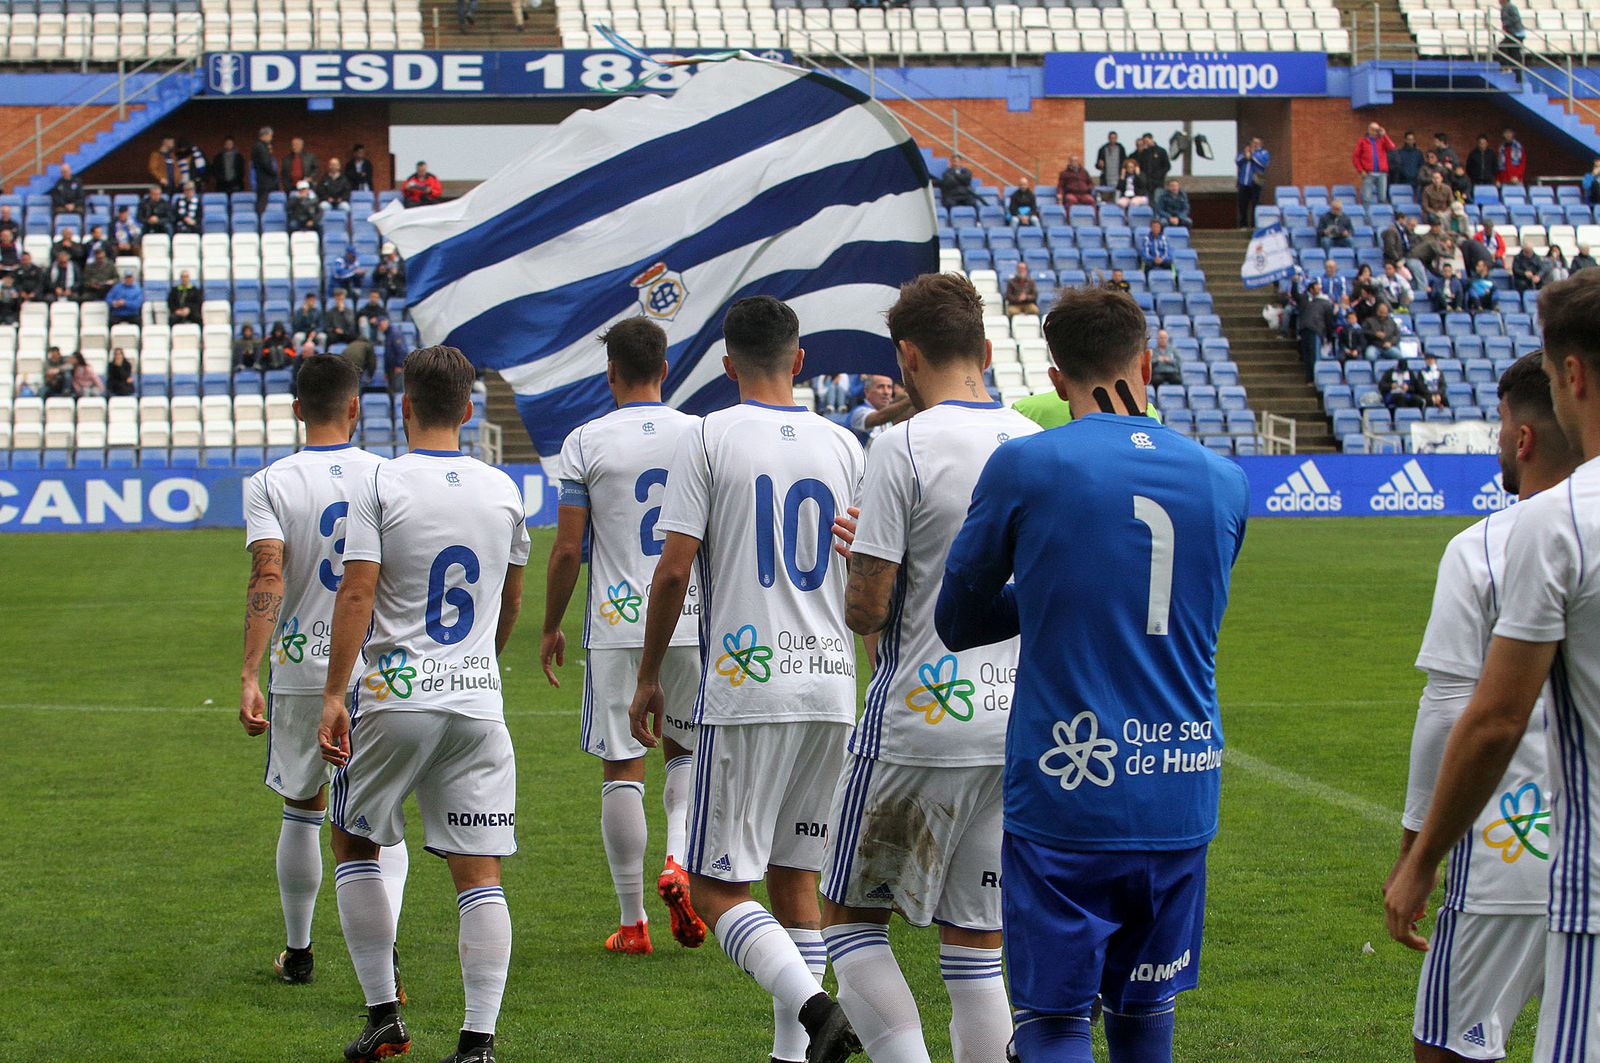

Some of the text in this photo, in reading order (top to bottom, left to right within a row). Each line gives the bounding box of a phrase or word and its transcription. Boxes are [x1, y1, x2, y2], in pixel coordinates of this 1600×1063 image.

[250, 53, 709, 91] DESDE 188
[1094, 55, 1279, 96] Cruzcampo
[634, 467, 670, 557] 2
[1266, 492, 1342, 512] adidas
[1370, 492, 1445, 512] adidas
[755, 473, 836, 592] 10
[319, 500, 350, 593] 3
[1133, 494, 1176, 636] 1
[425, 544, 481, 646] 6
[777, 630, 844, 652] Que sea
[462, 654, 491, 671] sea
[779, 654, 804, 675] de
[980, 662, 1018, 687] Que
[421, 676, 445, 692] de
[984, 689, 1009, 711] de
[1123, 718, 1212, 747] Que sea
[1125, 748, 1156, 775] de
[448, 812, 515, 827] ROMERO
